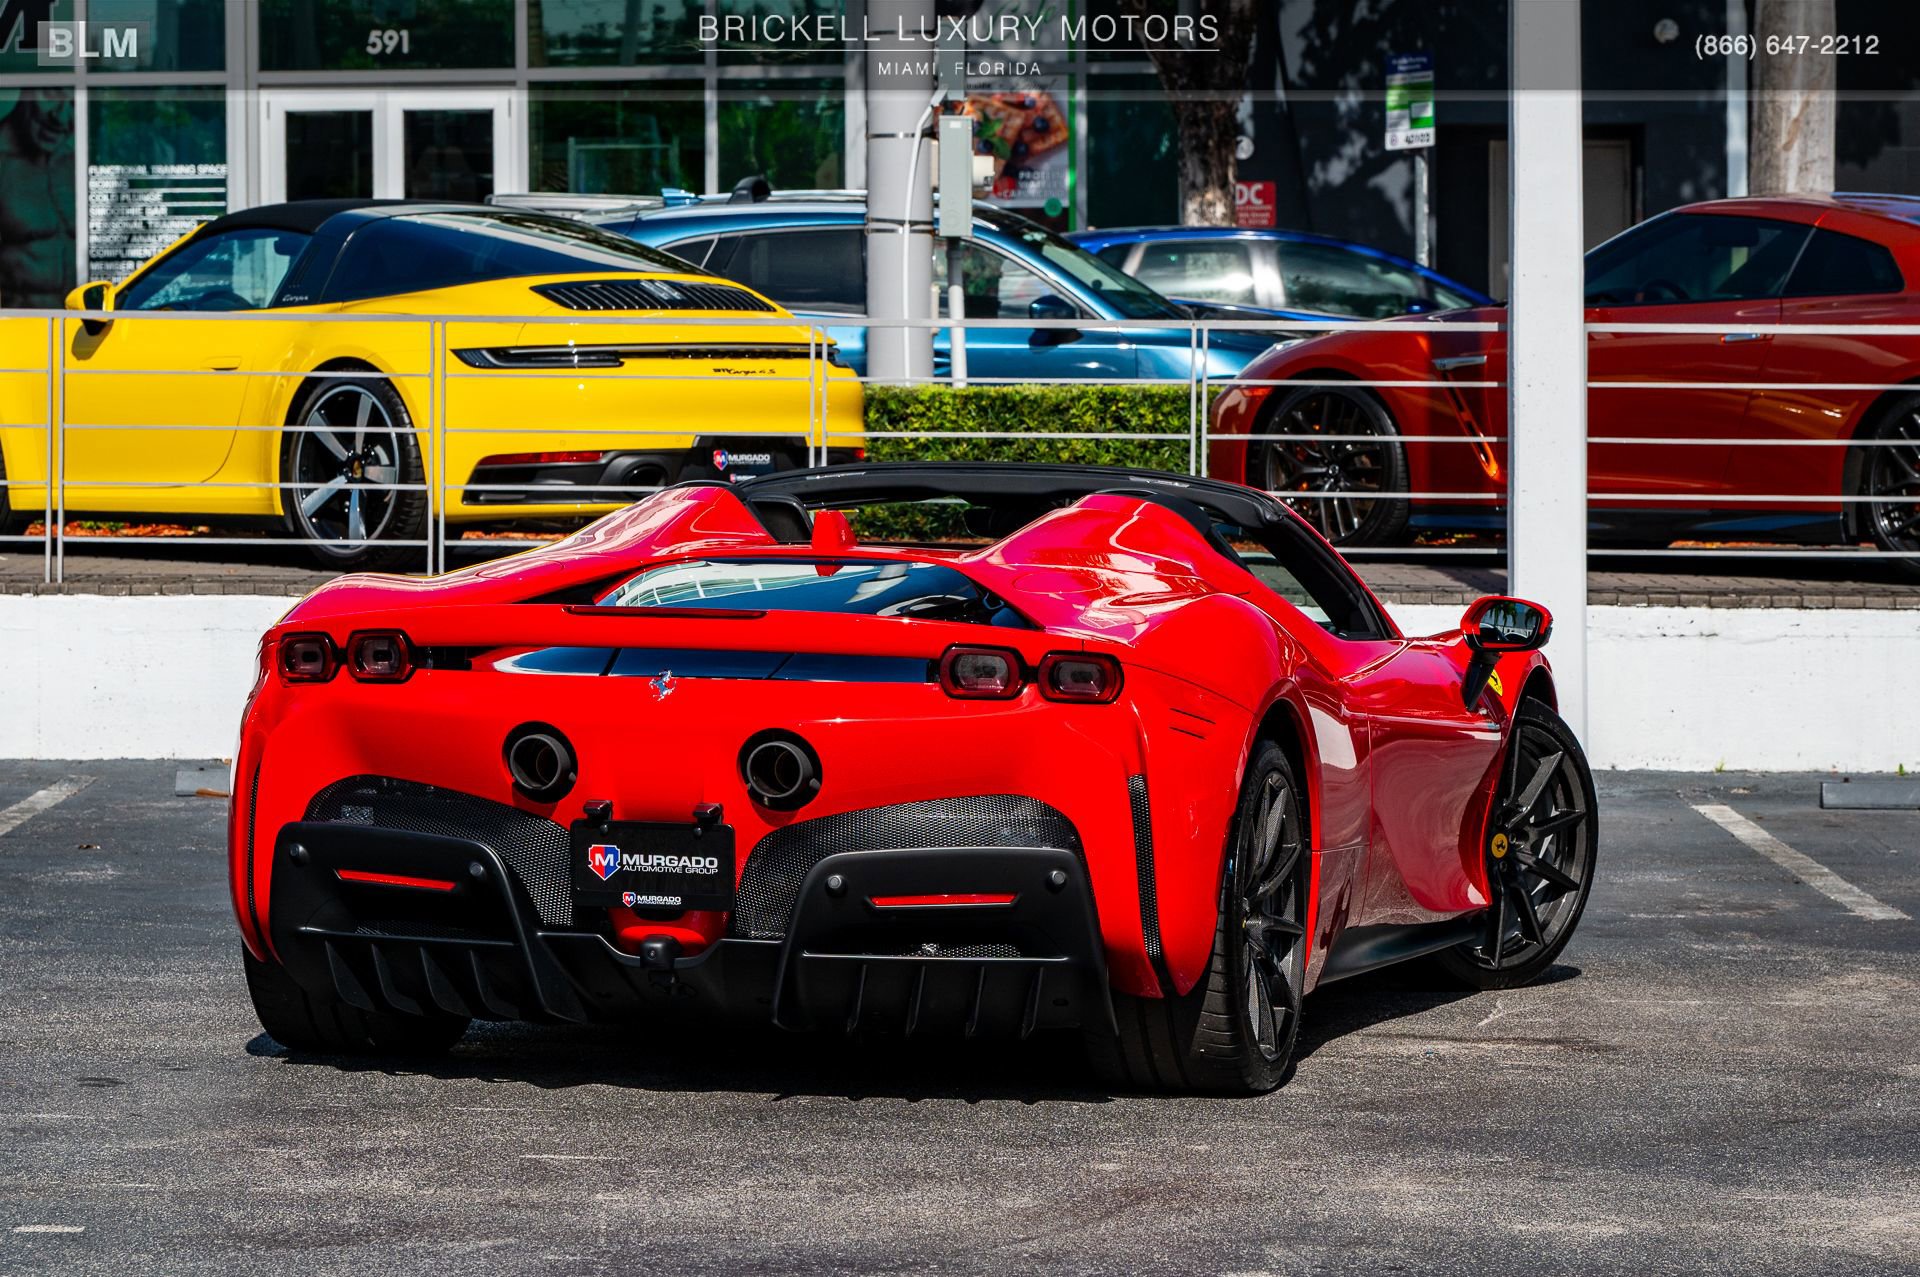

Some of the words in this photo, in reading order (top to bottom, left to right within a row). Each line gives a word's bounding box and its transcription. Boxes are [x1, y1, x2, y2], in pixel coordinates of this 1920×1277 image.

[366, 29, 409, 54] 591
[728, 454, 770, 462] MURGADO
[623, 853, 718, 869] MURGADO
[622, 865, 683, 874] AUTOMOTIVE
[685, 867, 719, 875] GROUP
